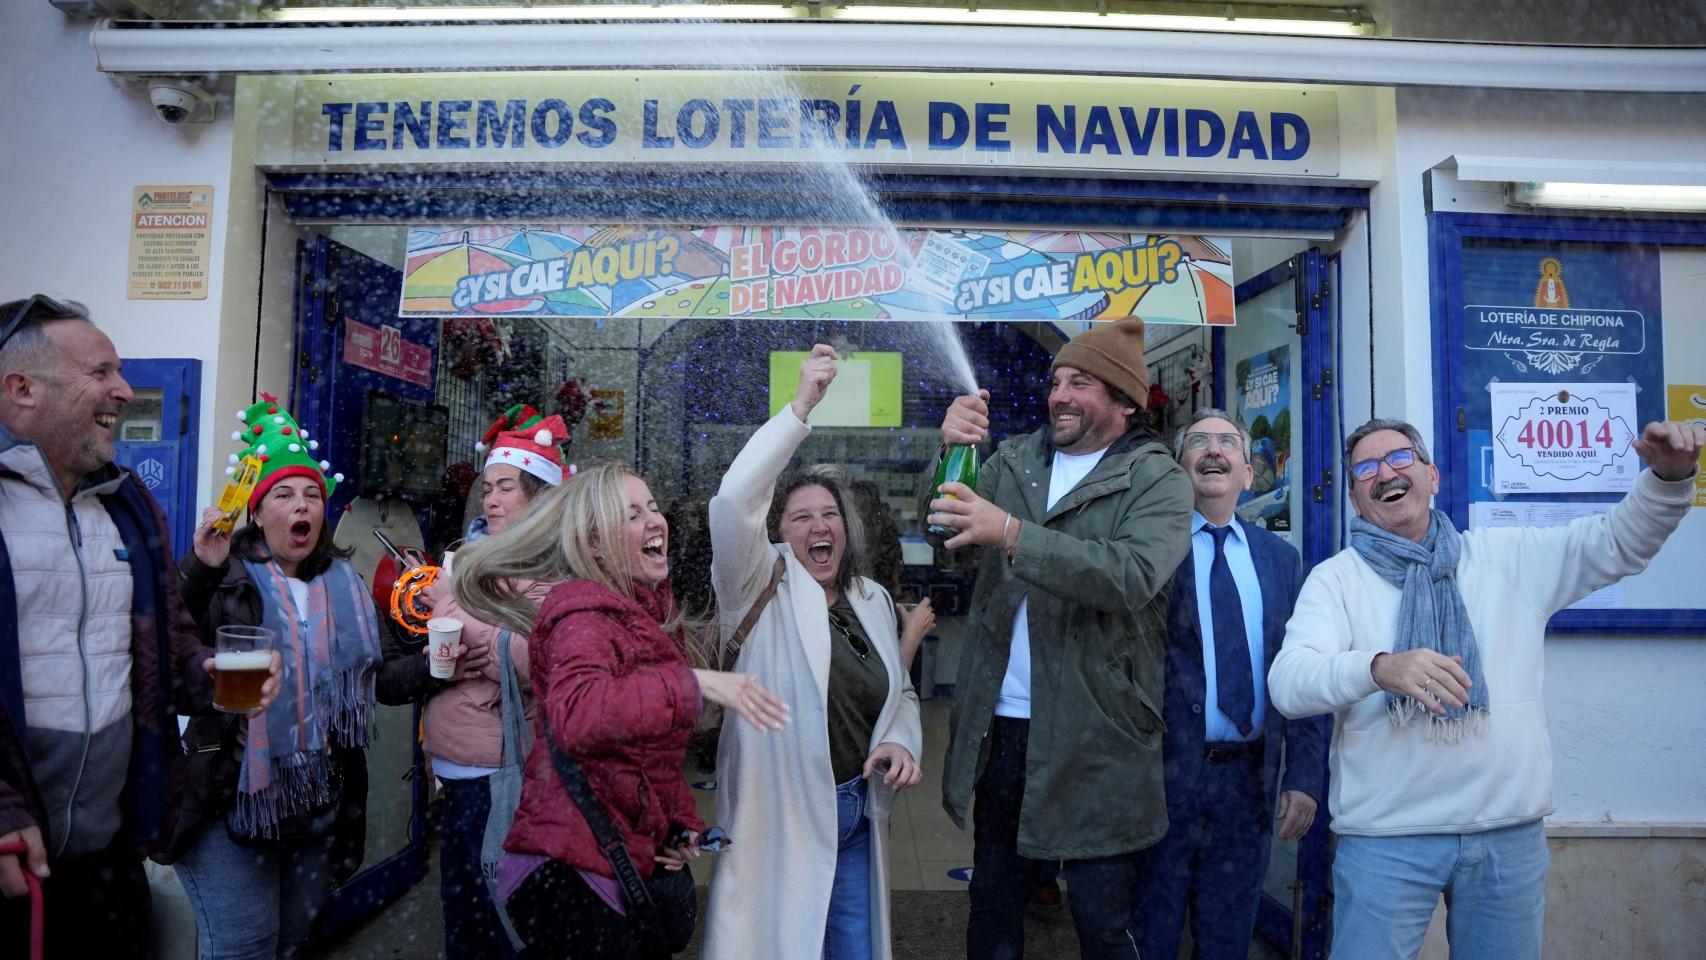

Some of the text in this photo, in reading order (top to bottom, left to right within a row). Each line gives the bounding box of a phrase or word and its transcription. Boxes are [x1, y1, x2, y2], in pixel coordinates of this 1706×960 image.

[321, 84, 1312, 161] TENEMOS LOTERÍA DE NAVIDAD
[138, 215, 205, 226] ATENCION
[510, 258, 565, 297] CAE
[567, 231, 679, 289] AQUÍ?
[731, 243, 769, 280] EL
[773, 228, 896, 275] GORDO
[1014, 262, 1069, 300] CAE
[1071, 236, 1182, 293] AQUÍ?
[730, 263, 904, 314] DE NAVIDAD
[1480, 310, 1624, 328] LOTERÍA DE CHIPIONA
[1487, 331, 1620, 352] Ntra. Sra. de Regla
[1540, 406, 1589, 415] 2 PREMIO
[1517, 419, 1614, 450] 40014
